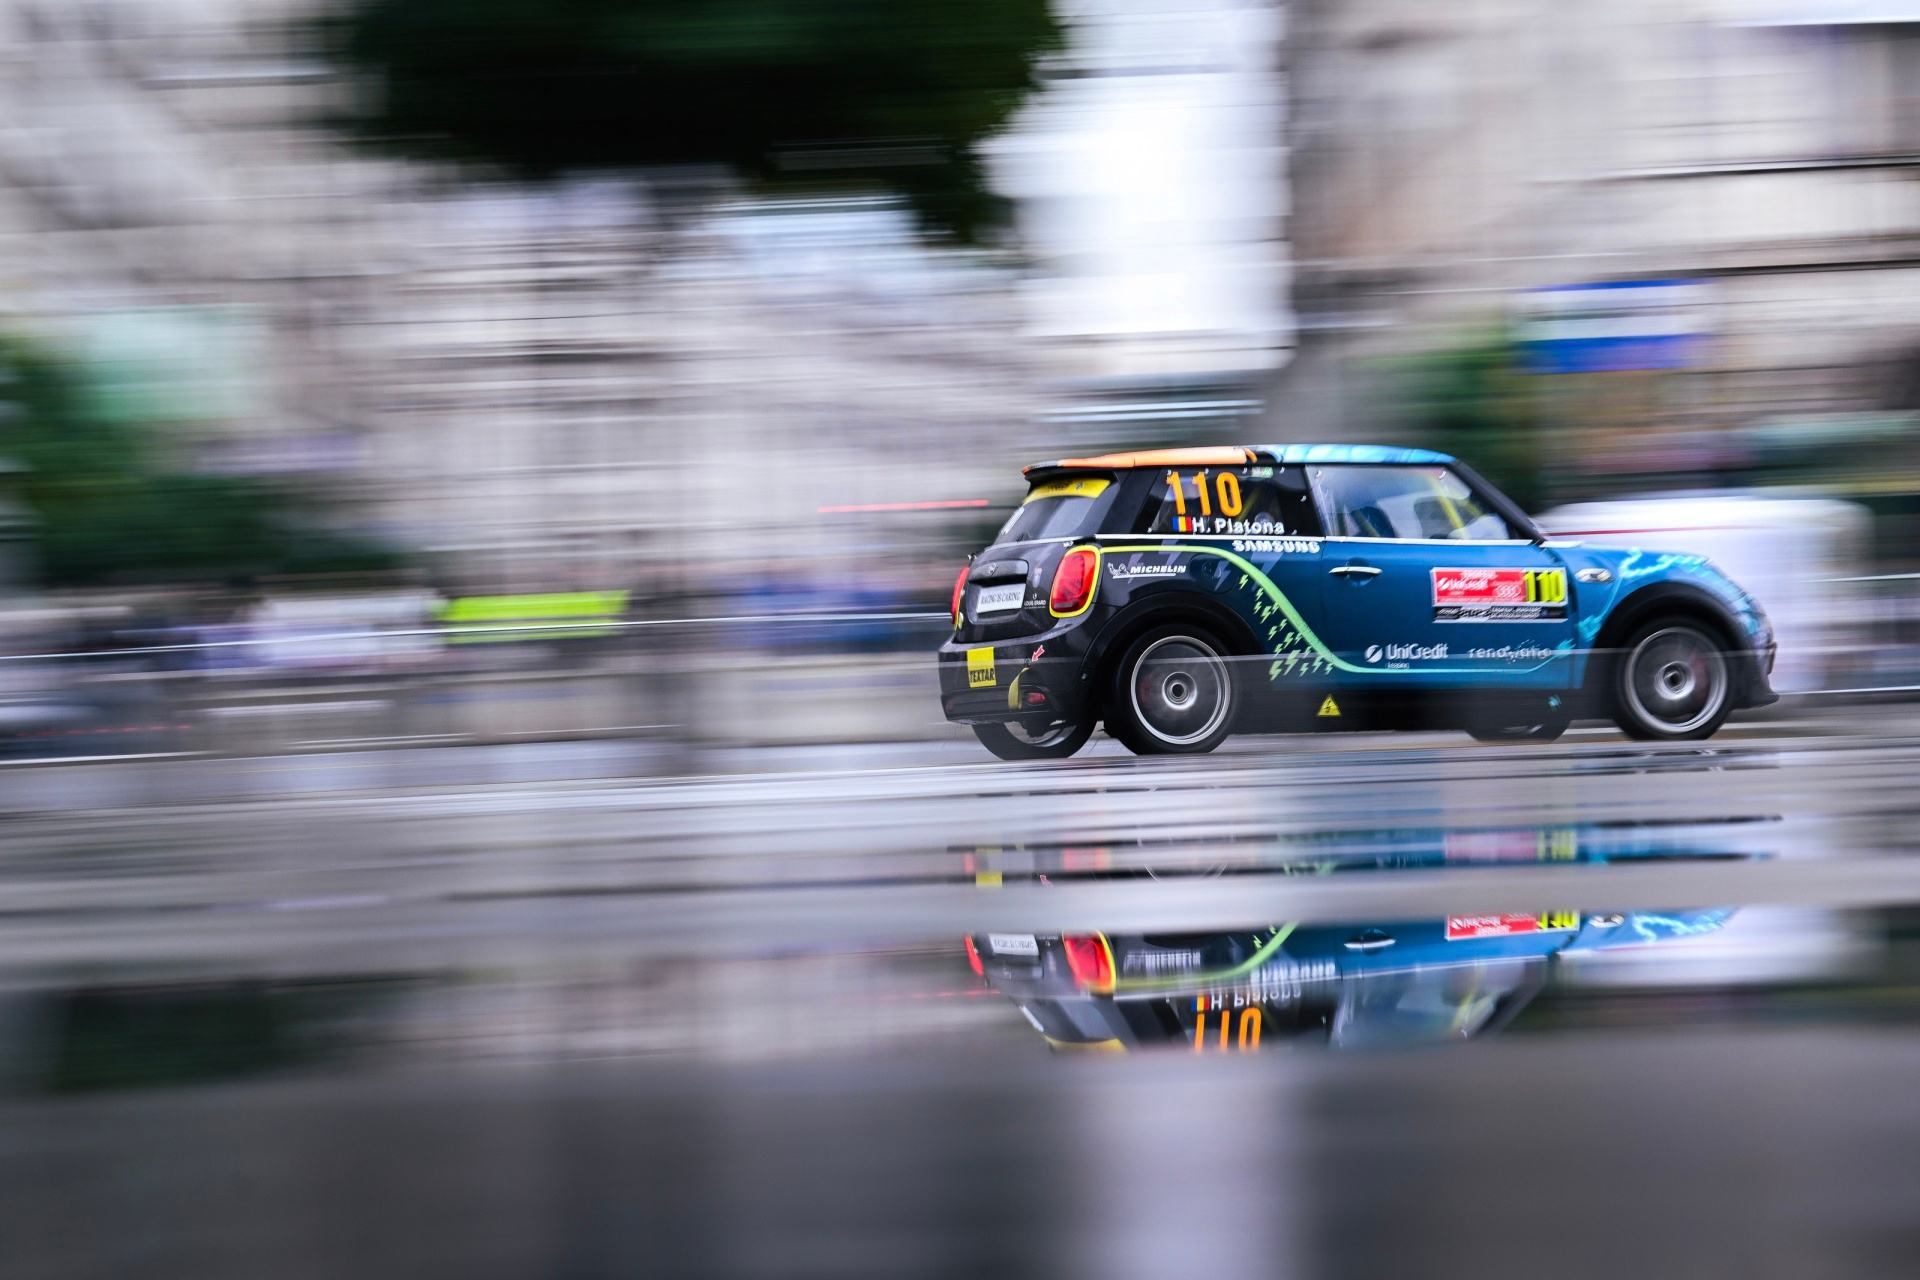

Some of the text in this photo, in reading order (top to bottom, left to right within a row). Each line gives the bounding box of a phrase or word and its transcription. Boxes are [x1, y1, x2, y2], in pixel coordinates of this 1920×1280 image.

[1166, 471, 1243, 517] 110
[1192, 517, 1285, 535] H. Platona
[1232, 540, 1320, 553] SAMSUNG
[1130, 565, 1187, 574] MICHELIN
[1522, 570, 1566, 603] 110
[1385, 642, 1449, 660] UniCredit
[969, 668, 995, 682] TEXTAR
